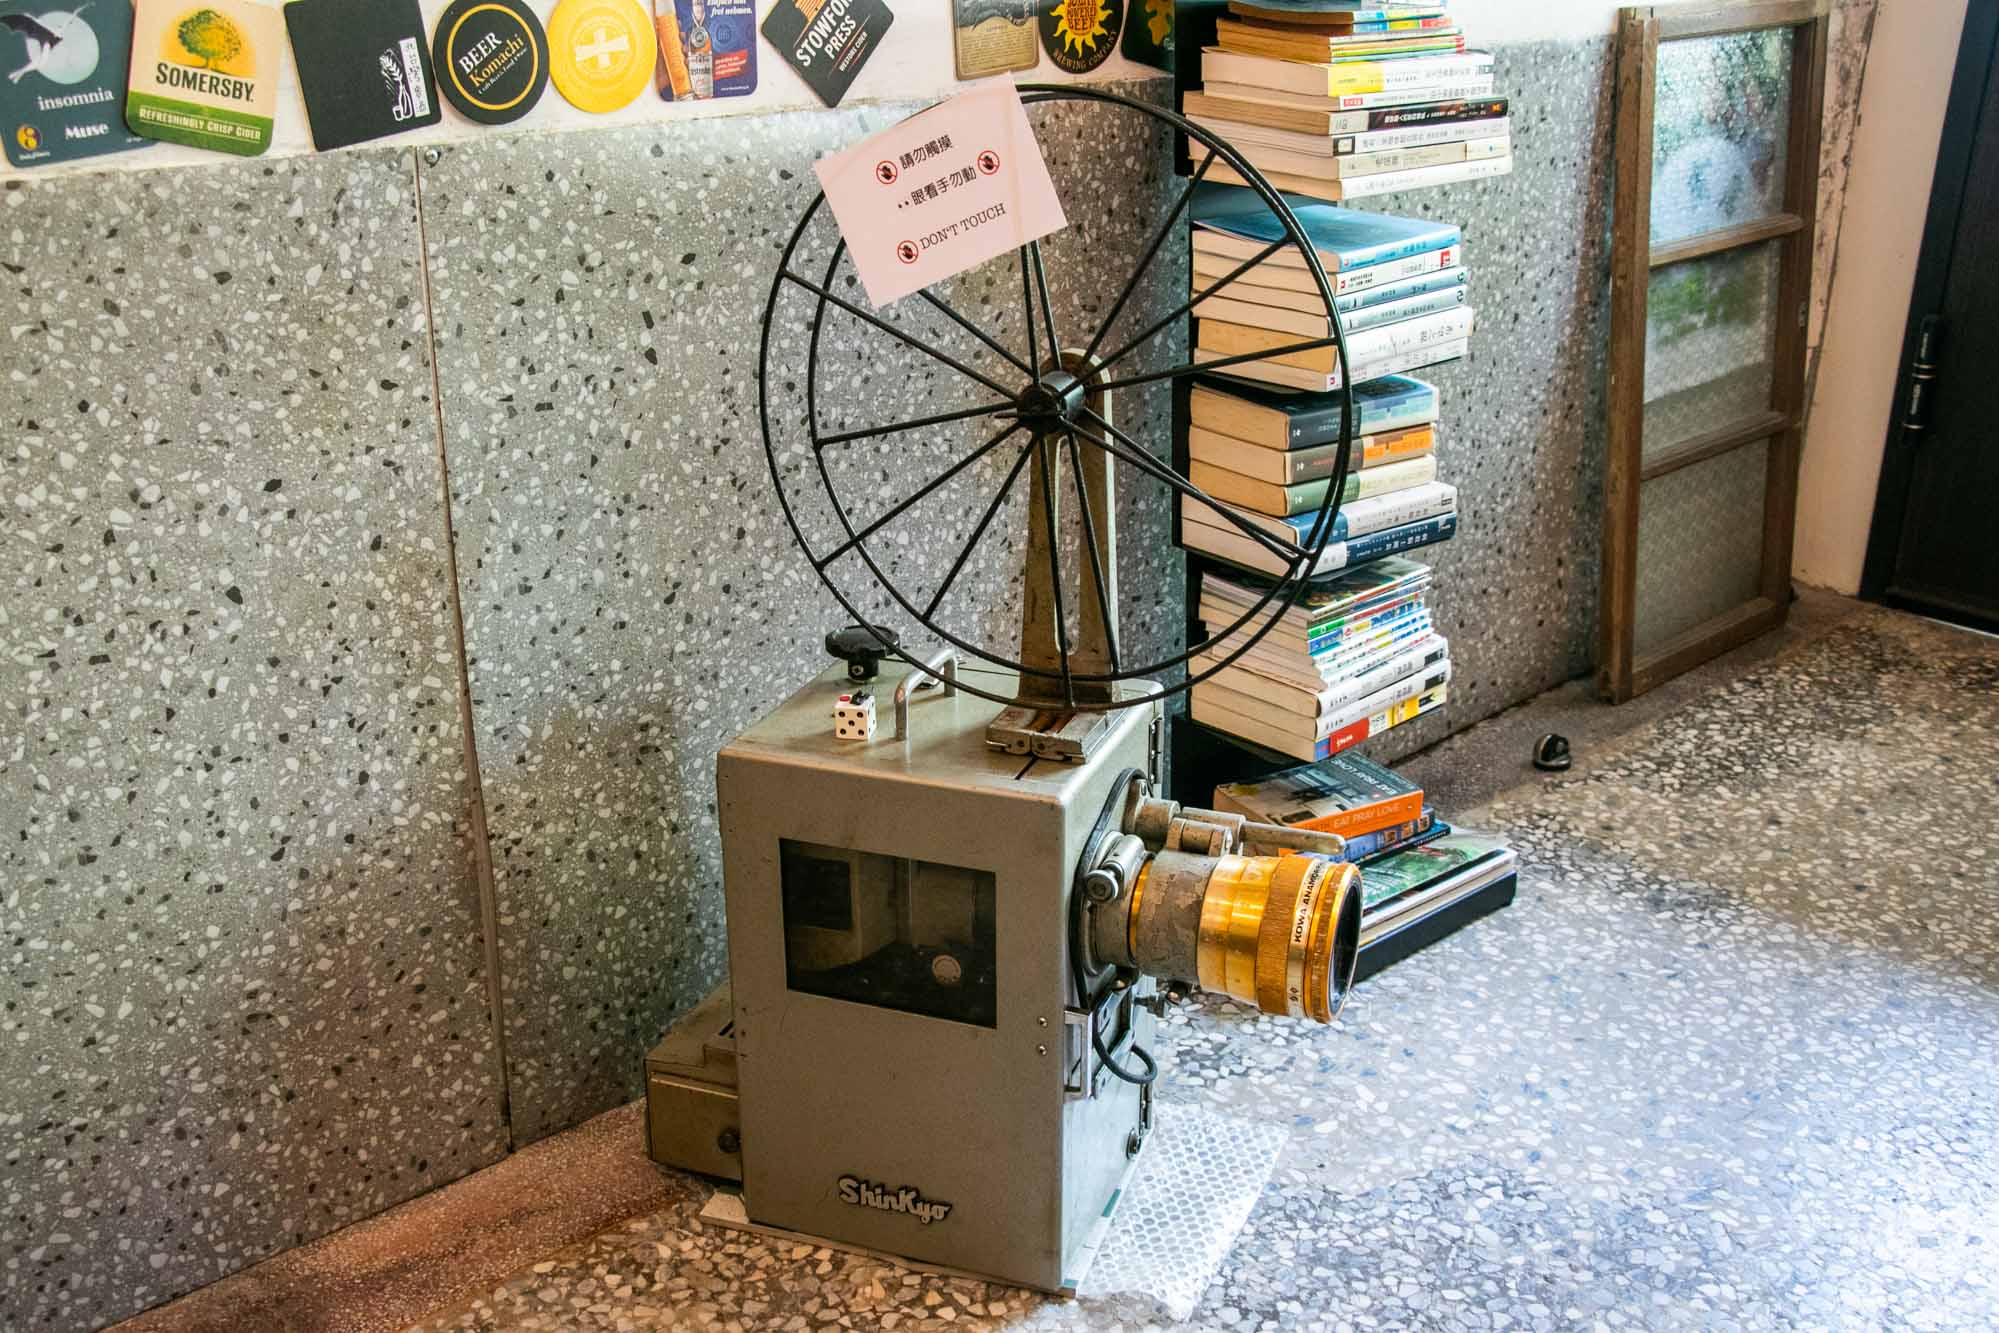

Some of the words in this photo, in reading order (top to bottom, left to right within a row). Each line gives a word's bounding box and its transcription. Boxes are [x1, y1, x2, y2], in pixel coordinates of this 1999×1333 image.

[824, 15, 857, 60] PRESS
[854, 31, 869, 49] CIDER
[1067, 17, 1096, 31] BEER
[459, 32, 502, 74] BEER
[469, 33, 525, 87] Komachi
[37, 87, 114, 111] insomnia
[64, 122, 109, 140] Muse
[138, 107, 205, 130] REFRESHINGLY
[207, 120, 233, 136] CRISP
[235, 126, 261, 140] CIDER
[899, 134, 953, 170] 請勿觸摸
[911, 165, 977, 206] 眼看手勿動
[959, 203, 1007, 233] TOUCH
[1333, 815, 1351, 828] EAT
[1352, 808, 1376, 822] PRAY
[1376, 803, 1401, 816] LOVE
[1294, 908, 1307, 943] KOWA
[838, 1174, 952, 1224] ShinKyo
